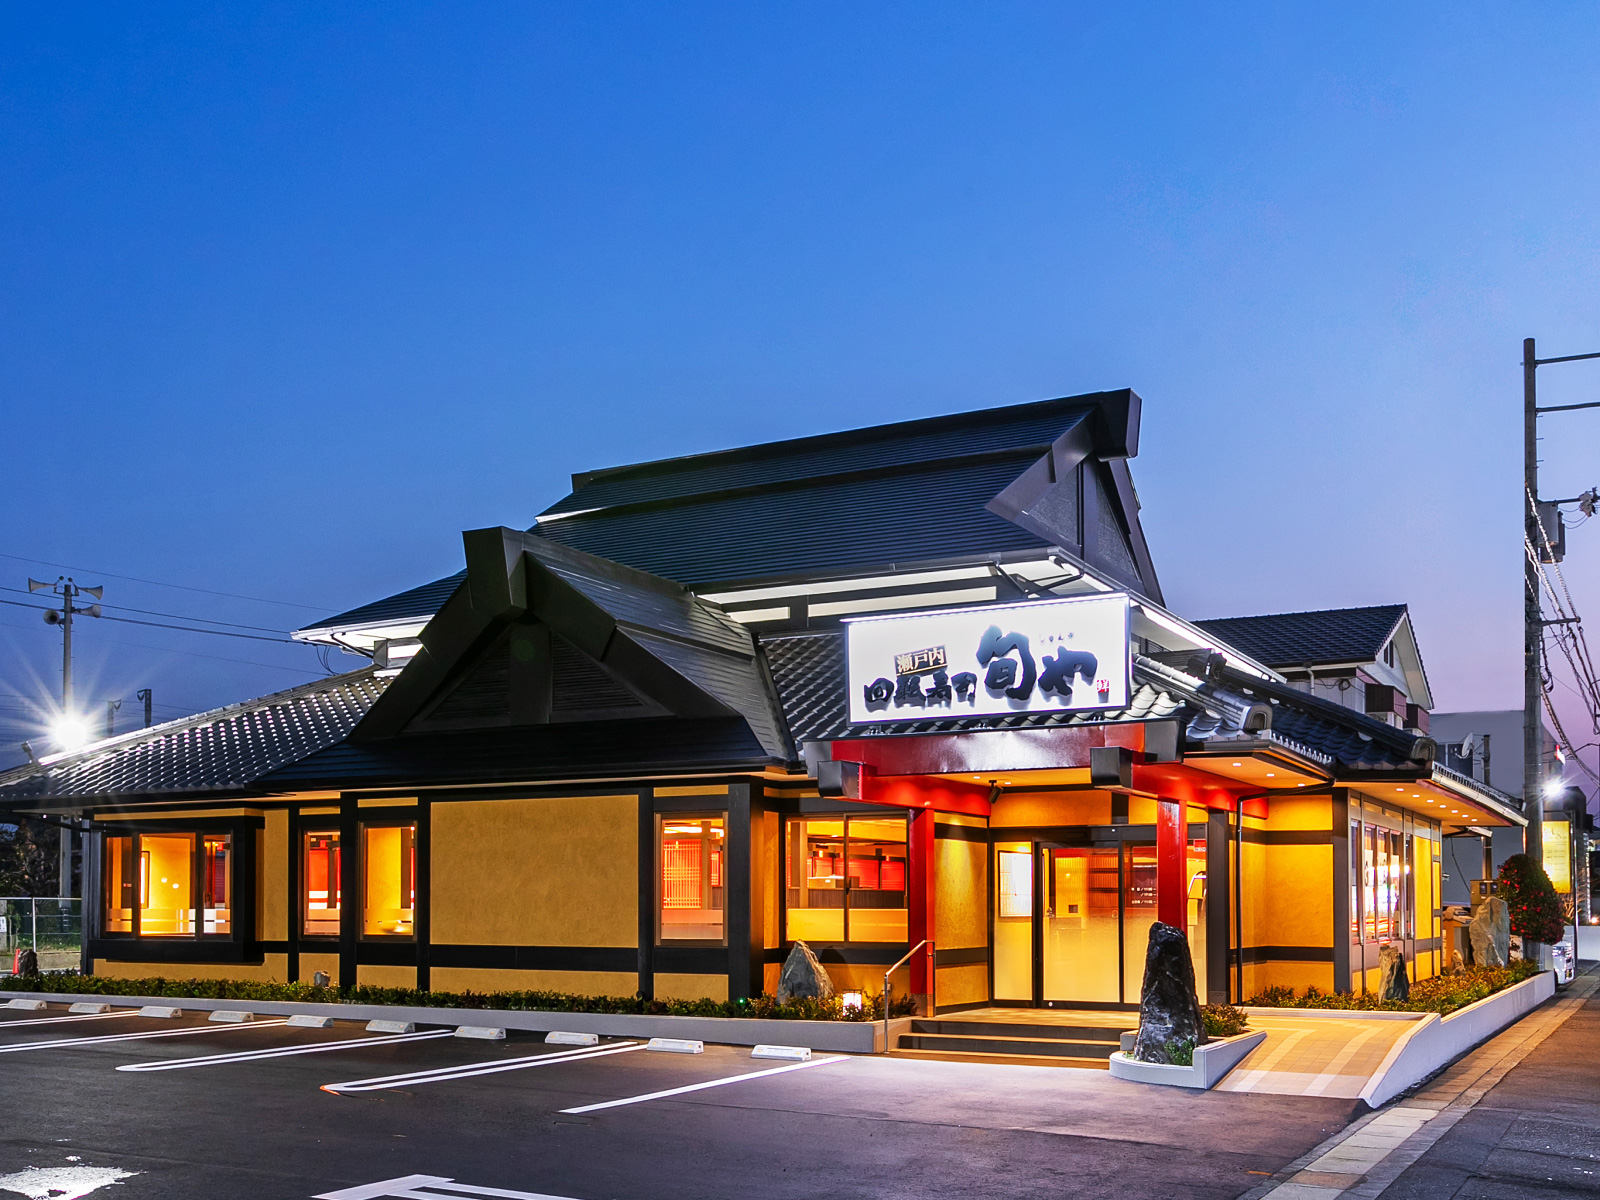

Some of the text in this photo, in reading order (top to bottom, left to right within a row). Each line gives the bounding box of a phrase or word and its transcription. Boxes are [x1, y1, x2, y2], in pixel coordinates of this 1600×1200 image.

[896, 647, 945, 673] 瀬戸内
[976, 624, 1098, 701] 旬や
[864, 671, 977, 703] 回転寿司
